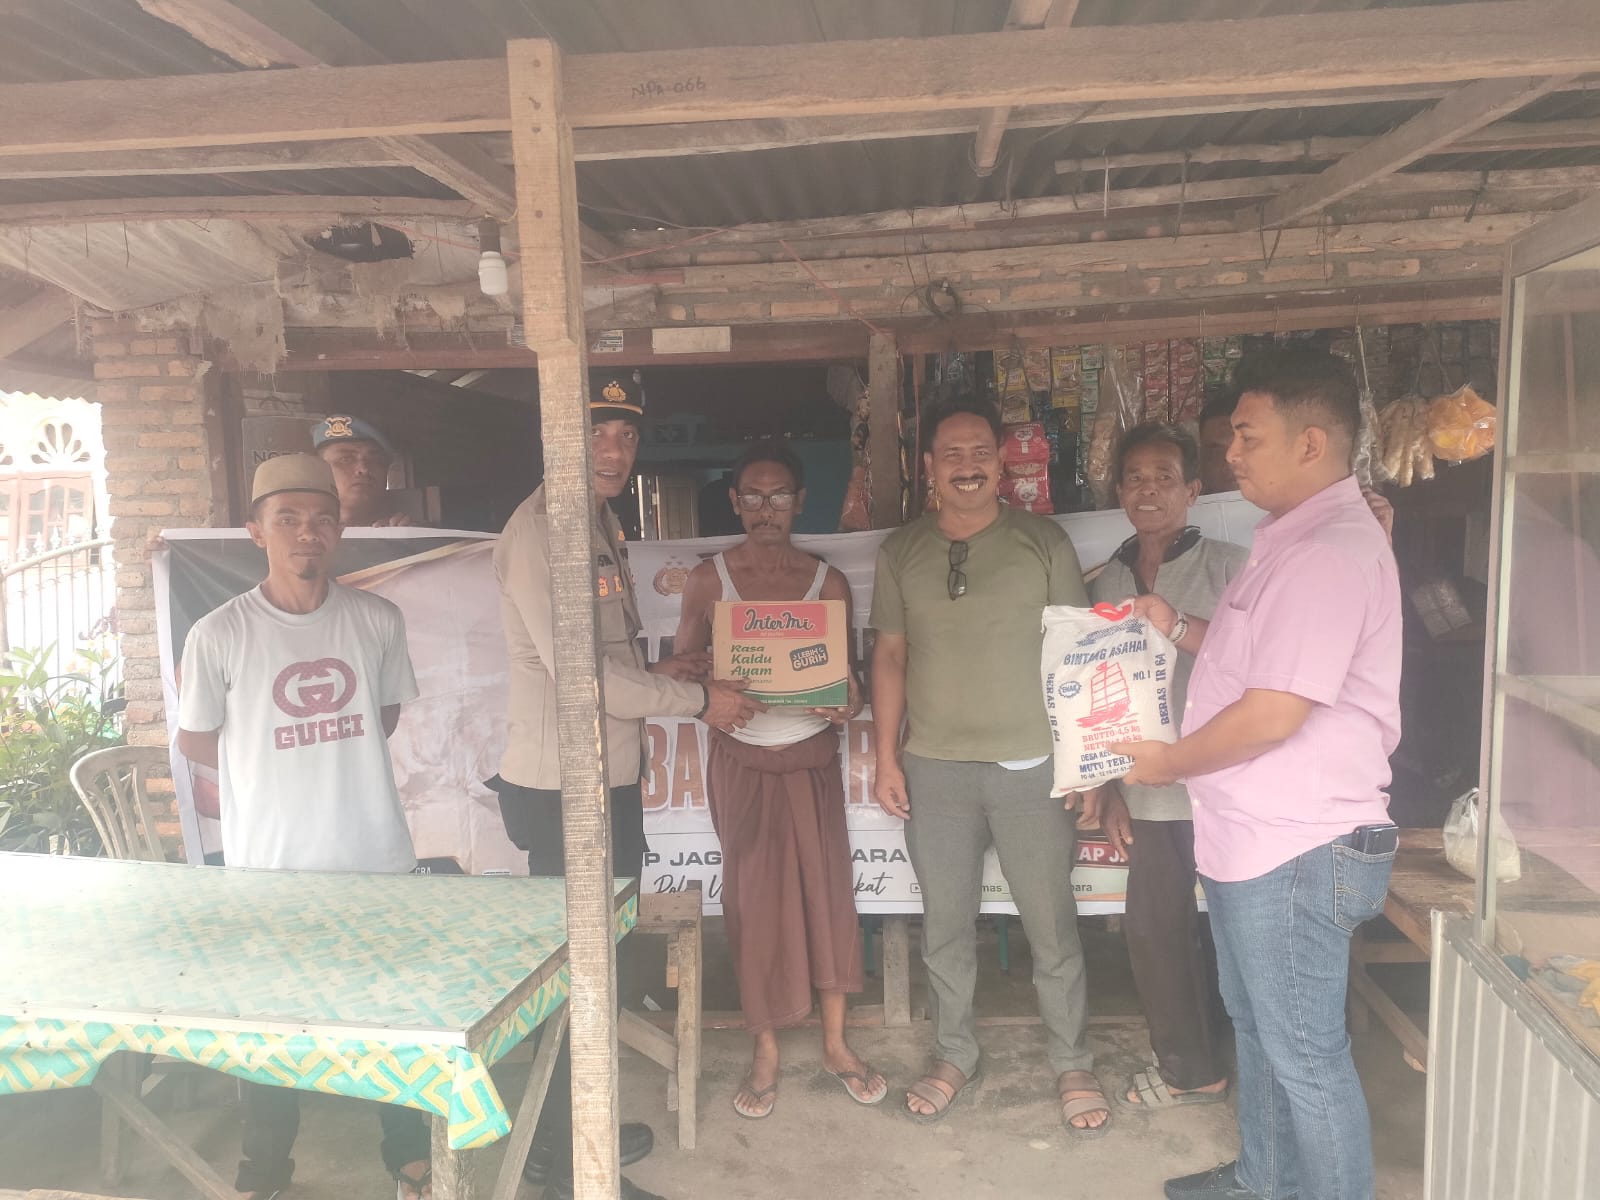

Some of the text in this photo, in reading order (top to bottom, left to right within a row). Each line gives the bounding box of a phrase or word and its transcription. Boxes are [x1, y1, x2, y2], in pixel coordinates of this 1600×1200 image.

[731, 645, 765, 653] Rasa
[797, 647, 819, 660] LEBIH
[731, 654, 772, 664] Kaldu
[793, 652, 827, 669] GURIH
[731, 665, 772, 679] Ayam
[1155, 669, 1166, 681] IR
[1158, 688, 1170, 724] BERAS
[274, 714, 365, 750] GUCCI
[1081, 752, 1098, 762] DESA
[1079, 762, 1104, 773] MUTU
[669, 850, 722, 867] JAG
[852, 848, 907, 863] ARA
[1078, 846, 1105, 861] AP
[854, 872, 894, 896] kat
